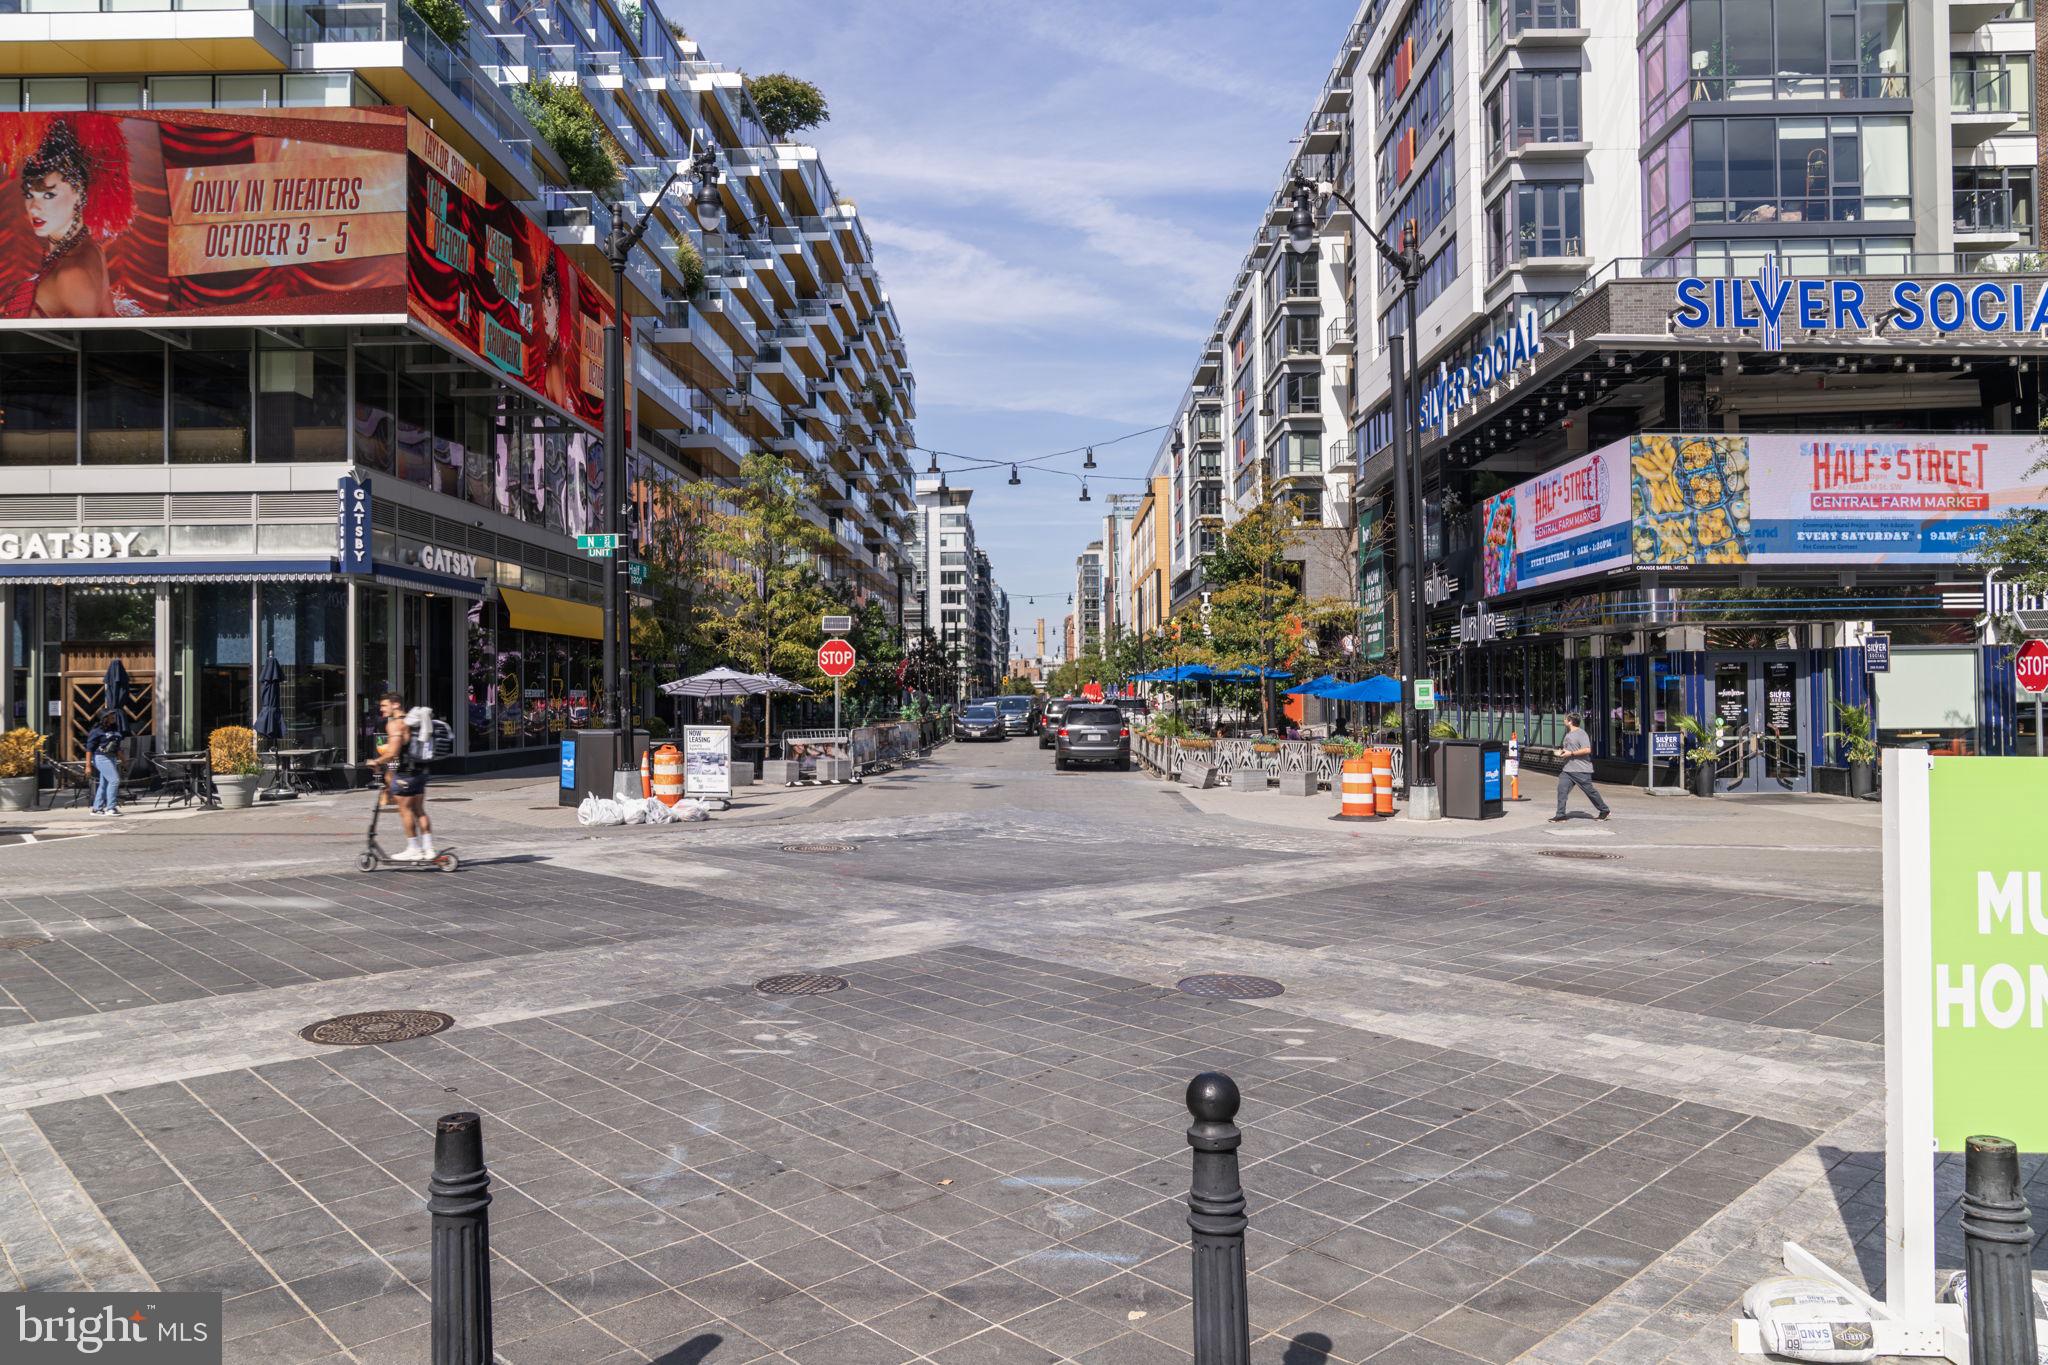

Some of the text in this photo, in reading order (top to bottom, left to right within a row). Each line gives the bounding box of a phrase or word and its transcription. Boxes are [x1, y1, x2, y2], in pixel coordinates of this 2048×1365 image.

[424, 131, 472, 193] TAYLOR SWIFT
[191, 176, 363, 214] ONLY IN THEATERS
[205, 223, 291, 258] OCTOBER
[296, 222, 311, 256] 3
[334, 221, 350, 255] 5
[434, 218, 469, 274] OFFICIAL
[1675, 277, 1869, 331] SILVER
[487, 324, 522, 371] SHOWGIRL
[1418, 310, 1539, 434] SILVER SOCIAL
[1813, 442, 1989, 491] HALF STREET
[1535, 454, 1600, 524] HALF STREET
[1813, 496, 1984, 509] CENTRAL FARM MARKET
[353, 488, 366, 562] GATSBY
[1559, 516, 1576, 532] FARM
[1576, 507, 1600, 527] MARKET
[1797, 531, 1837, 541] EVERY
[1841, 531, 1910, 541] SATURDAY
[1930, 531, 1958, 541] 9AM
[0, 531, 141, 560] GATSBY
[587, 536, 595, 549] N
[588, 548, 610, 557] UNIT
[421, 545, 478, 579] GATSBY
[629, 563, 640, 576] Half
[821, 651, 853, 665] STOP
[1867, 643, 1887, 652] SILVER
[1800, 1329, 1830, 1339] SAND
